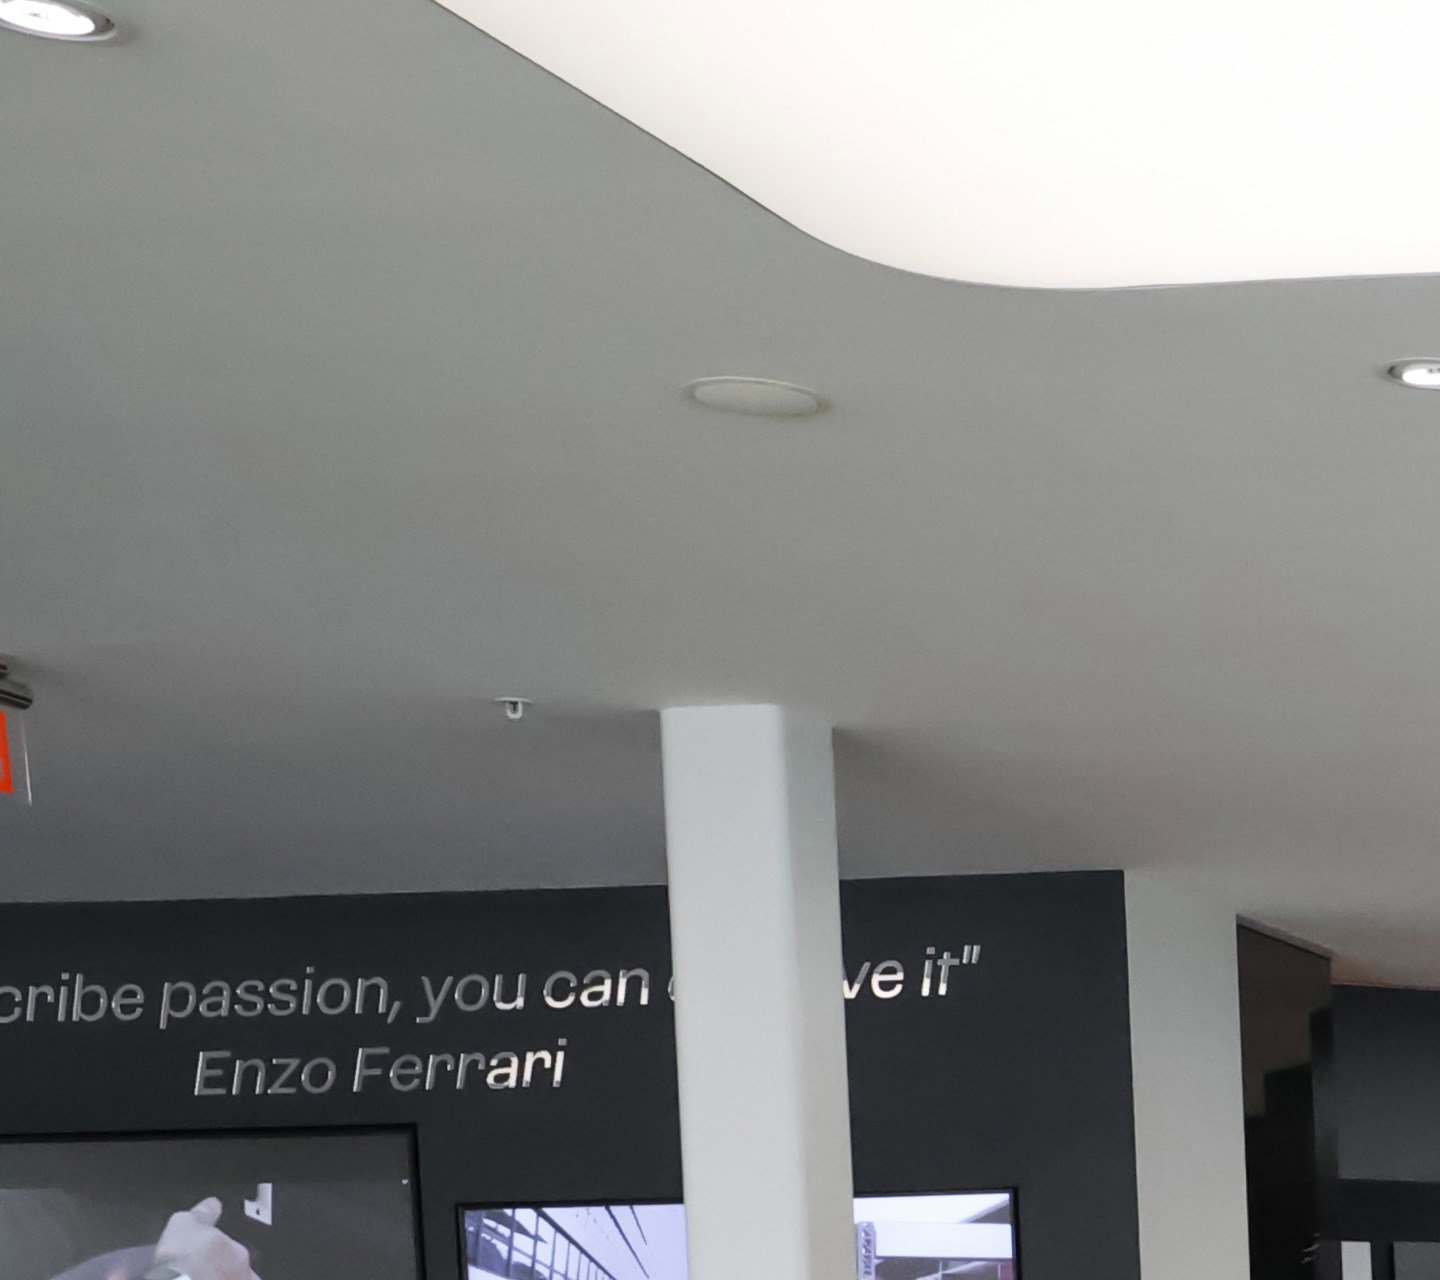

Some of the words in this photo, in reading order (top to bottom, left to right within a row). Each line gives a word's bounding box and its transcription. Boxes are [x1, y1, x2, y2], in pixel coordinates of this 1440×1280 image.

[159, 966, 402, 1029] passion,
[415, 973, 526, 1024] you
[543, 967, 650, 1009] can
[842, 959, 904, 1000] ve
[194, 1049, 337, 1096] Enzo
[352, 1038, 567, 1093] Ferrari
